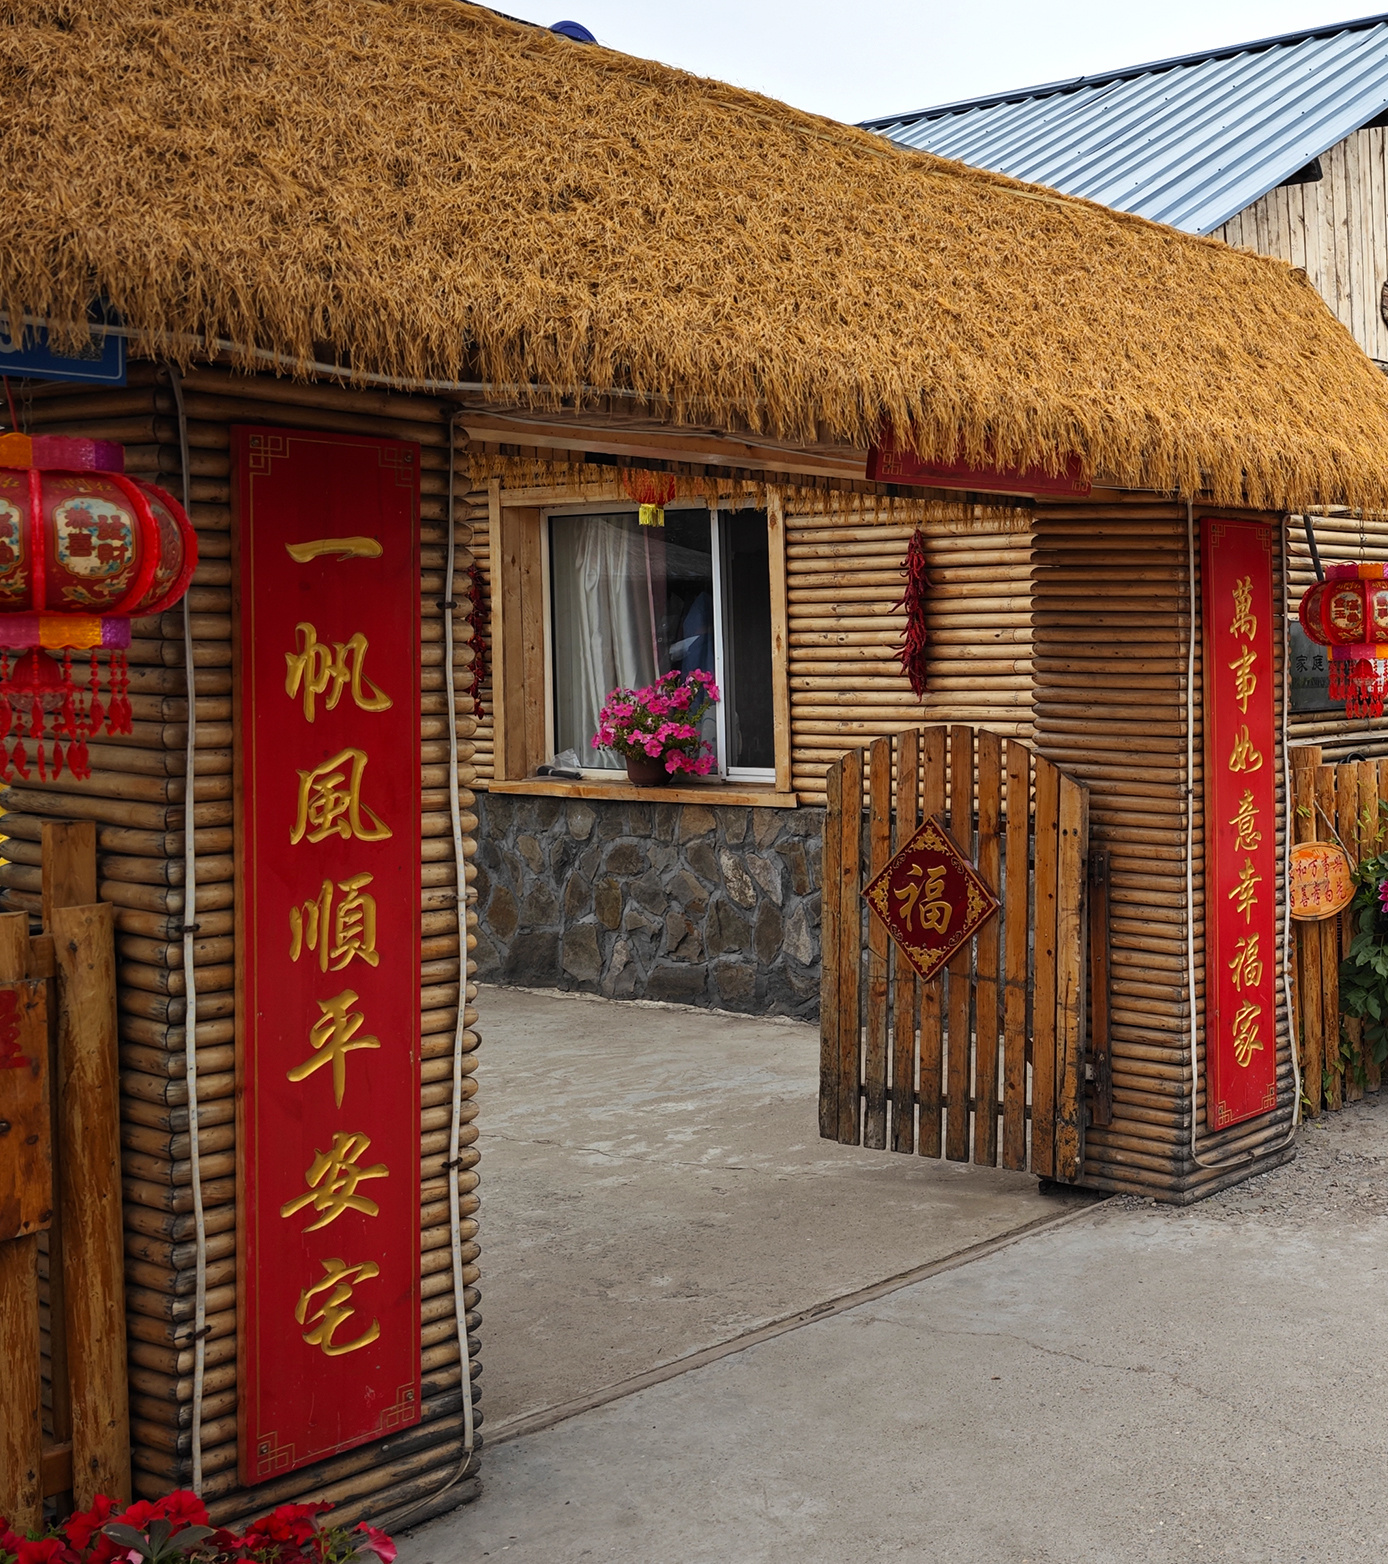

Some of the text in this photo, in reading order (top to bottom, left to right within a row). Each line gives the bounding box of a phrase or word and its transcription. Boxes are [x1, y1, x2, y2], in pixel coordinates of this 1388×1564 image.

[280, 536, 394, 1356] 一帆風順平安宅
[893, 863, 953, 935] 福
[1228, 575, 1264, 1067] 萬事如意幸福家
